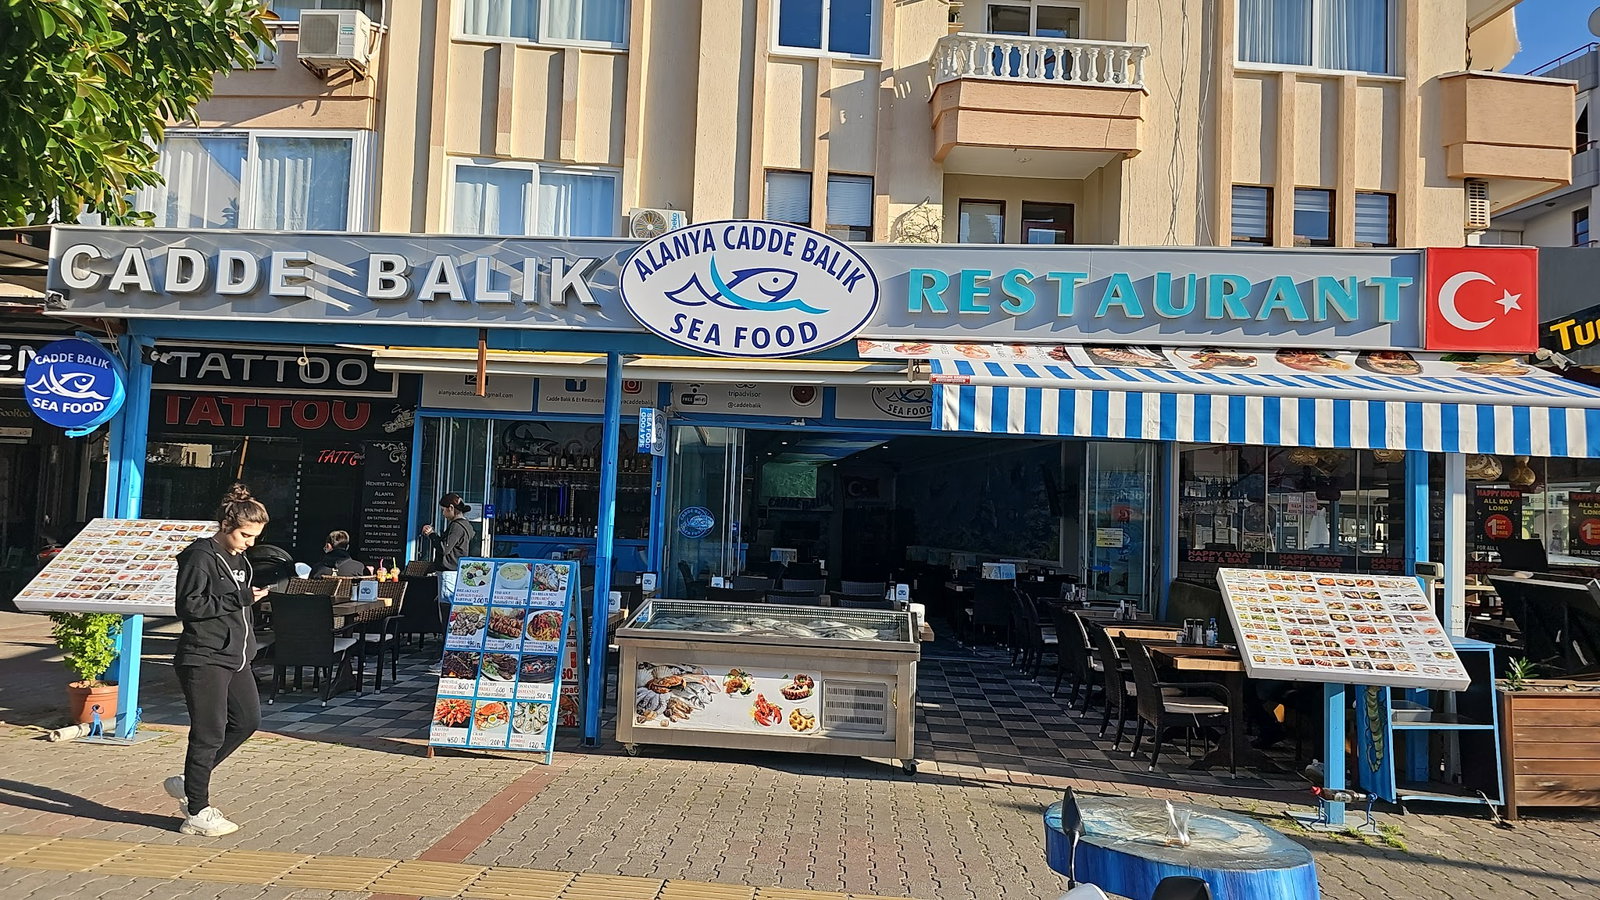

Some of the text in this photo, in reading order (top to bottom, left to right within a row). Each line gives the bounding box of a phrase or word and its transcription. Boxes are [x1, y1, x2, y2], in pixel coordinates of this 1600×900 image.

[670, 212, 678, 231] beko
[633, 226, 866, 294] ALANYA CADDE BALIK
[60, 244, 602, 307] CADDE BALIK
[907, 267, 1414, 323] RESTAURANT
[669, 312, 818, 349] SEA FOOD
[34, 353, 110, 370] CADDE BALIK
[168, 351, 368, 386] TATTOO
[728, 390, 761, 399] tripadvisor
[32, 397, 104, 414] SEA FOOD
[887, 403, 932, 416] SEA FOOD
[1476, 489, 1520, 498] HAPPY HOUR
[1188, 550, 1251, 559] HAPPY DAYS
[1279, 554, 1313, 562] HAPPY
